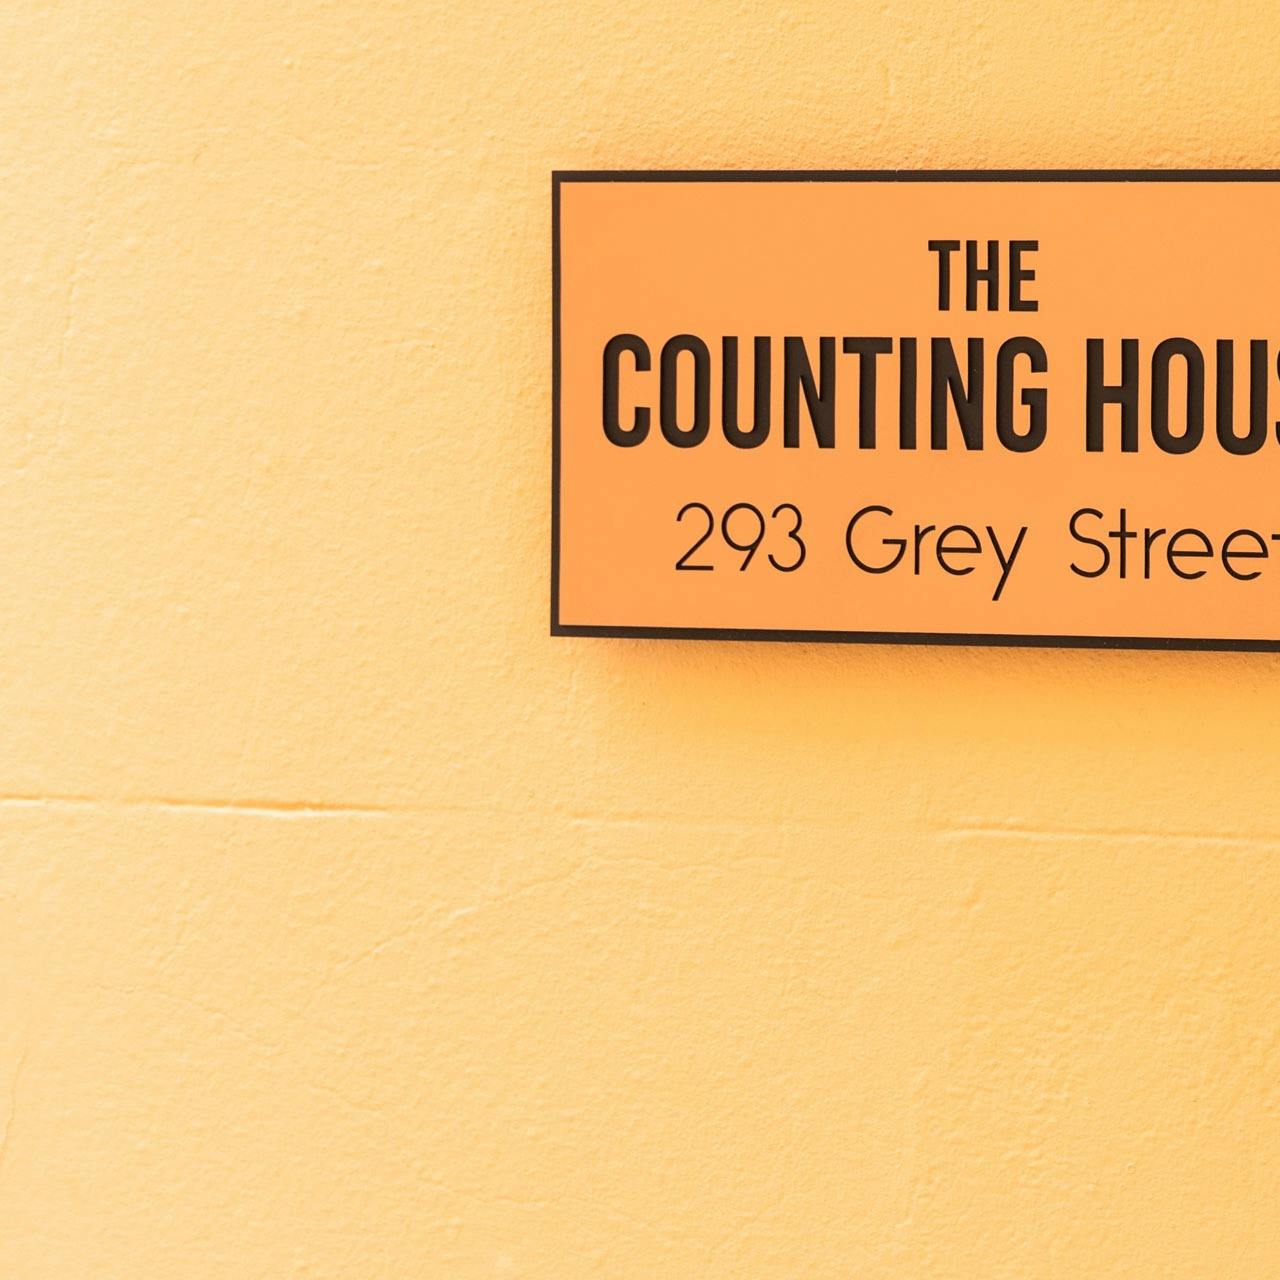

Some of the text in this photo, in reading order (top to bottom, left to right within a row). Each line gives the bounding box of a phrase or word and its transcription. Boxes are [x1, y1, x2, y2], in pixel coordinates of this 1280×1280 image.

[926, 239, 1040, 313] THE
[601, 333, 1049, 454] COUNTING
[675, 502, 808, 573] 293
[845, 505, 1029, 602] Grey
